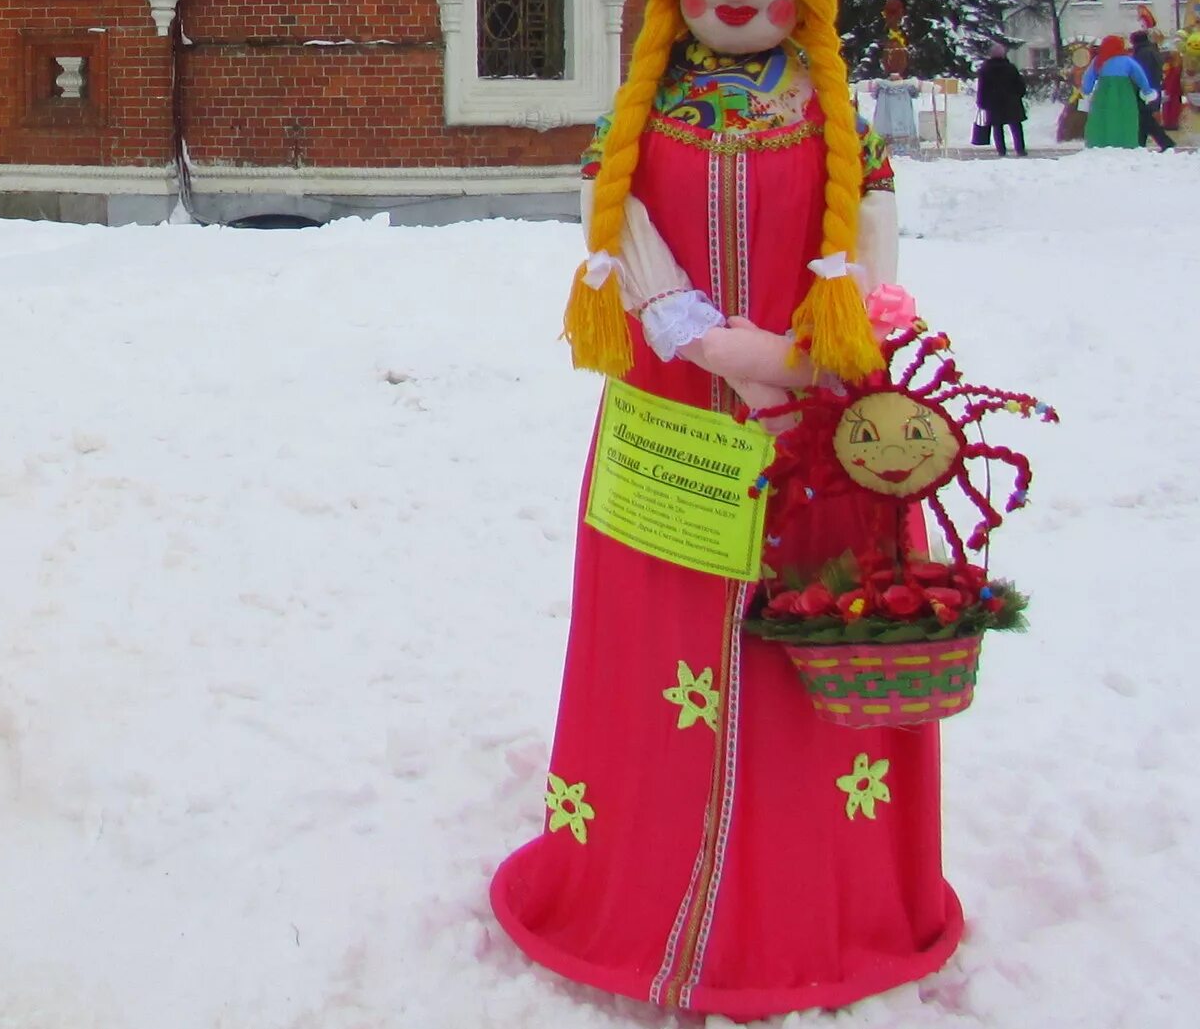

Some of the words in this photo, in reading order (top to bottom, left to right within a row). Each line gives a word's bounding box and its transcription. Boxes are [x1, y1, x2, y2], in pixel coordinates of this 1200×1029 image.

[613, 424, 741, 478] «Покровительница
[639, 410, 687, 434] «Детский
[690, 428, 710, 442] сад
[712, 432, 728, 446] №
[731, 437, 753, 452] 28»
[607, 447, 641, 471] солнца
[651, 463, 741, 504] Светозара»
